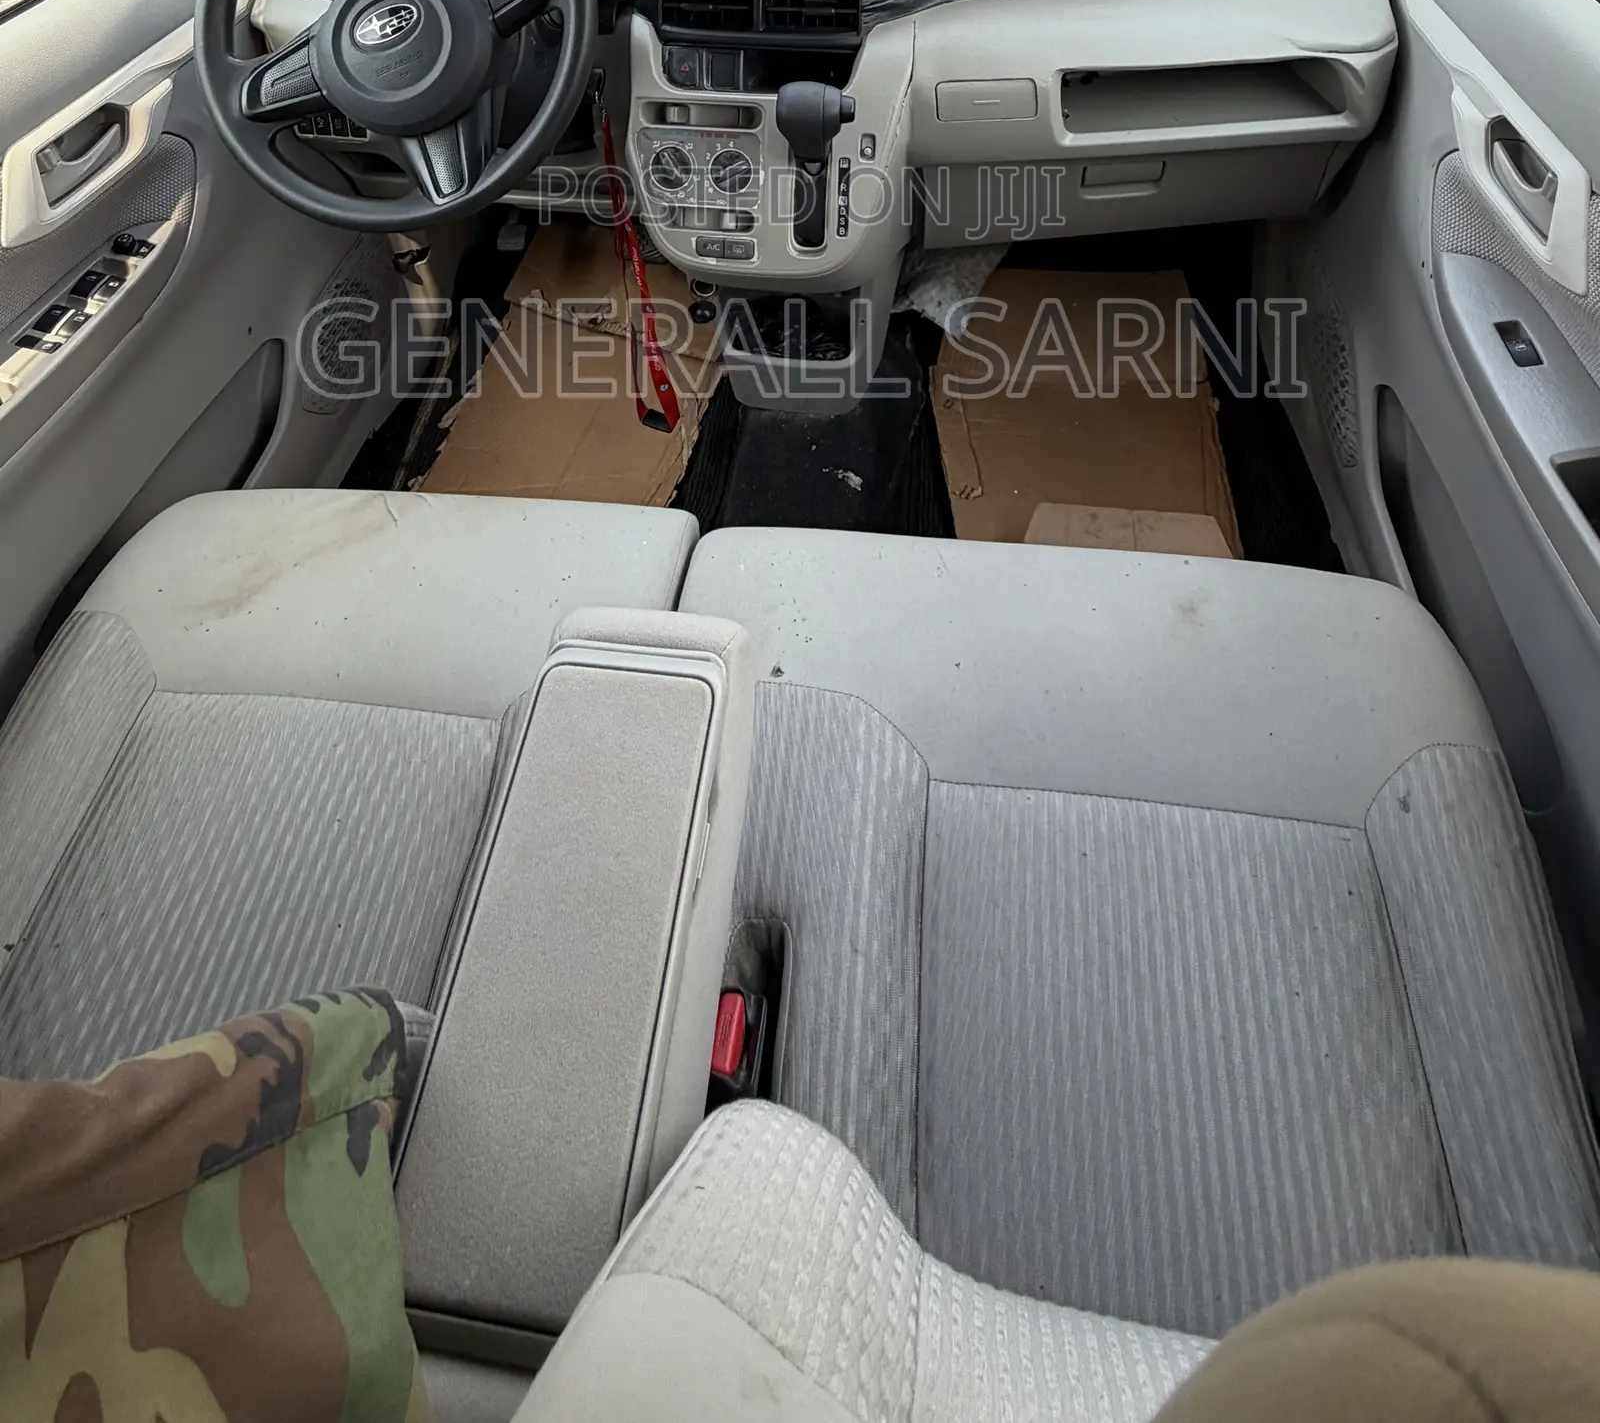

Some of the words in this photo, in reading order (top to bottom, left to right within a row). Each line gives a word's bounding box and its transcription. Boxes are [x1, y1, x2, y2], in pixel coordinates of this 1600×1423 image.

[716, 143, 721, 151] 3
[841, 160, 849, 169] P
[840, 183, 847, 192] R
[840, 196, 848, 206] N
[840, 207, 846, 216] D
[840, 217, 846, 226] S
[839, 227, 846, 236] B
[706, 242, 721, 252] A/C
